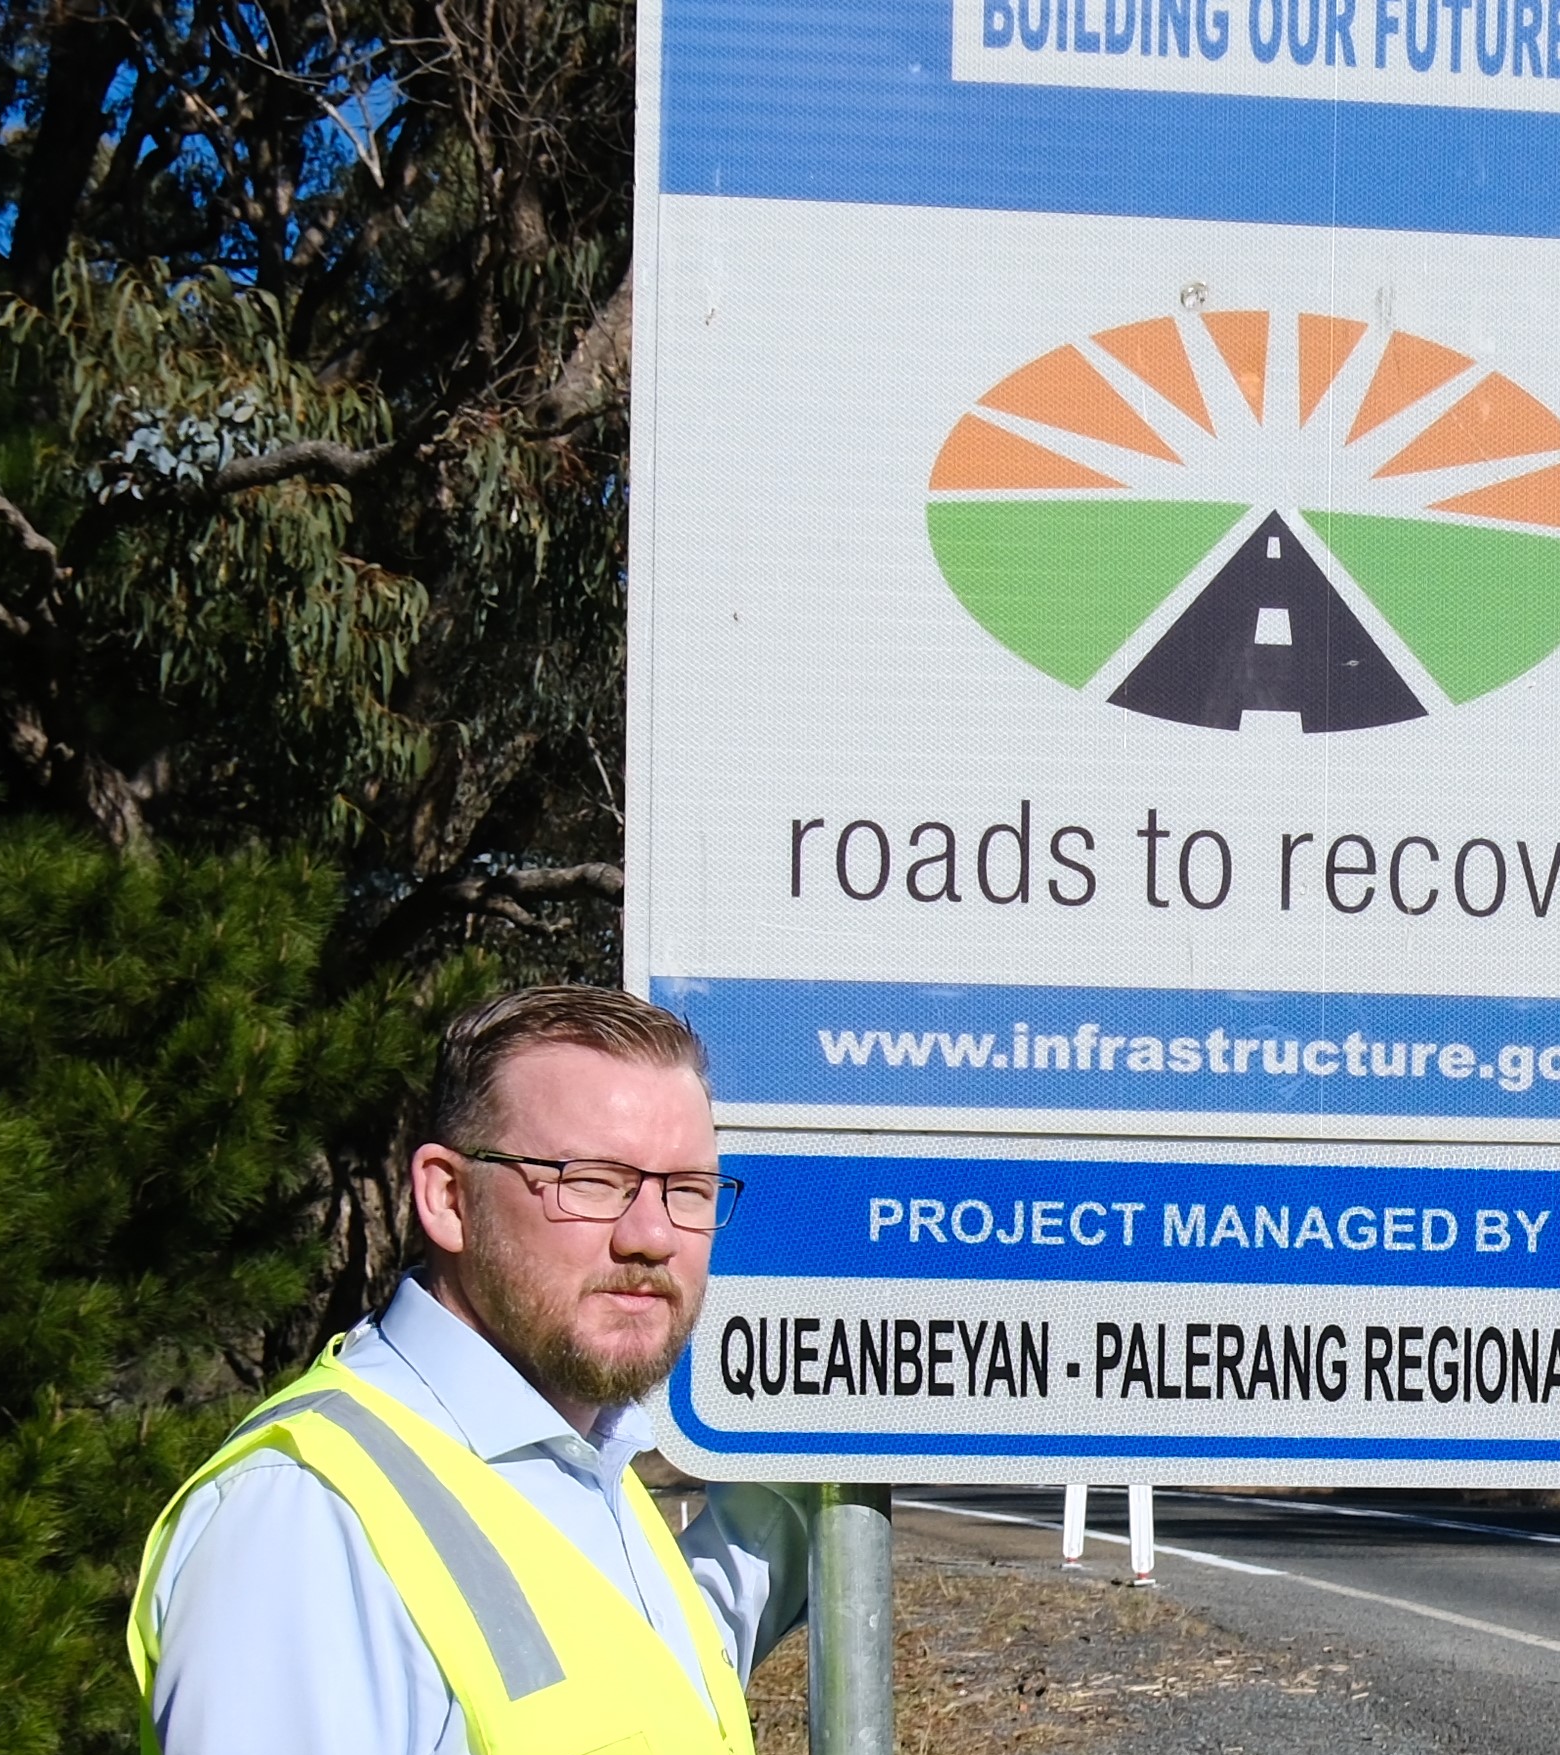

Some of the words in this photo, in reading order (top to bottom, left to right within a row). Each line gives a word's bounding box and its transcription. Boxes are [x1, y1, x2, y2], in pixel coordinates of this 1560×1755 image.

[982, 0, 1230, 61] BUILDING
[1248, 0, 1357, 68] OUR
[790, 799, 1097, 907] roads
[1136, 808, 1233, 911] to
[869, 1197, 1146, 1247] PROJECT
[1163, 1203, 1459, 1252] MANAGED
[1475, 1209, 1550, 1253] BY
[720, 1315, 1049, 1401] QUEANBEYAN
[1095, 1321, 1348, 1403] PALERANG
